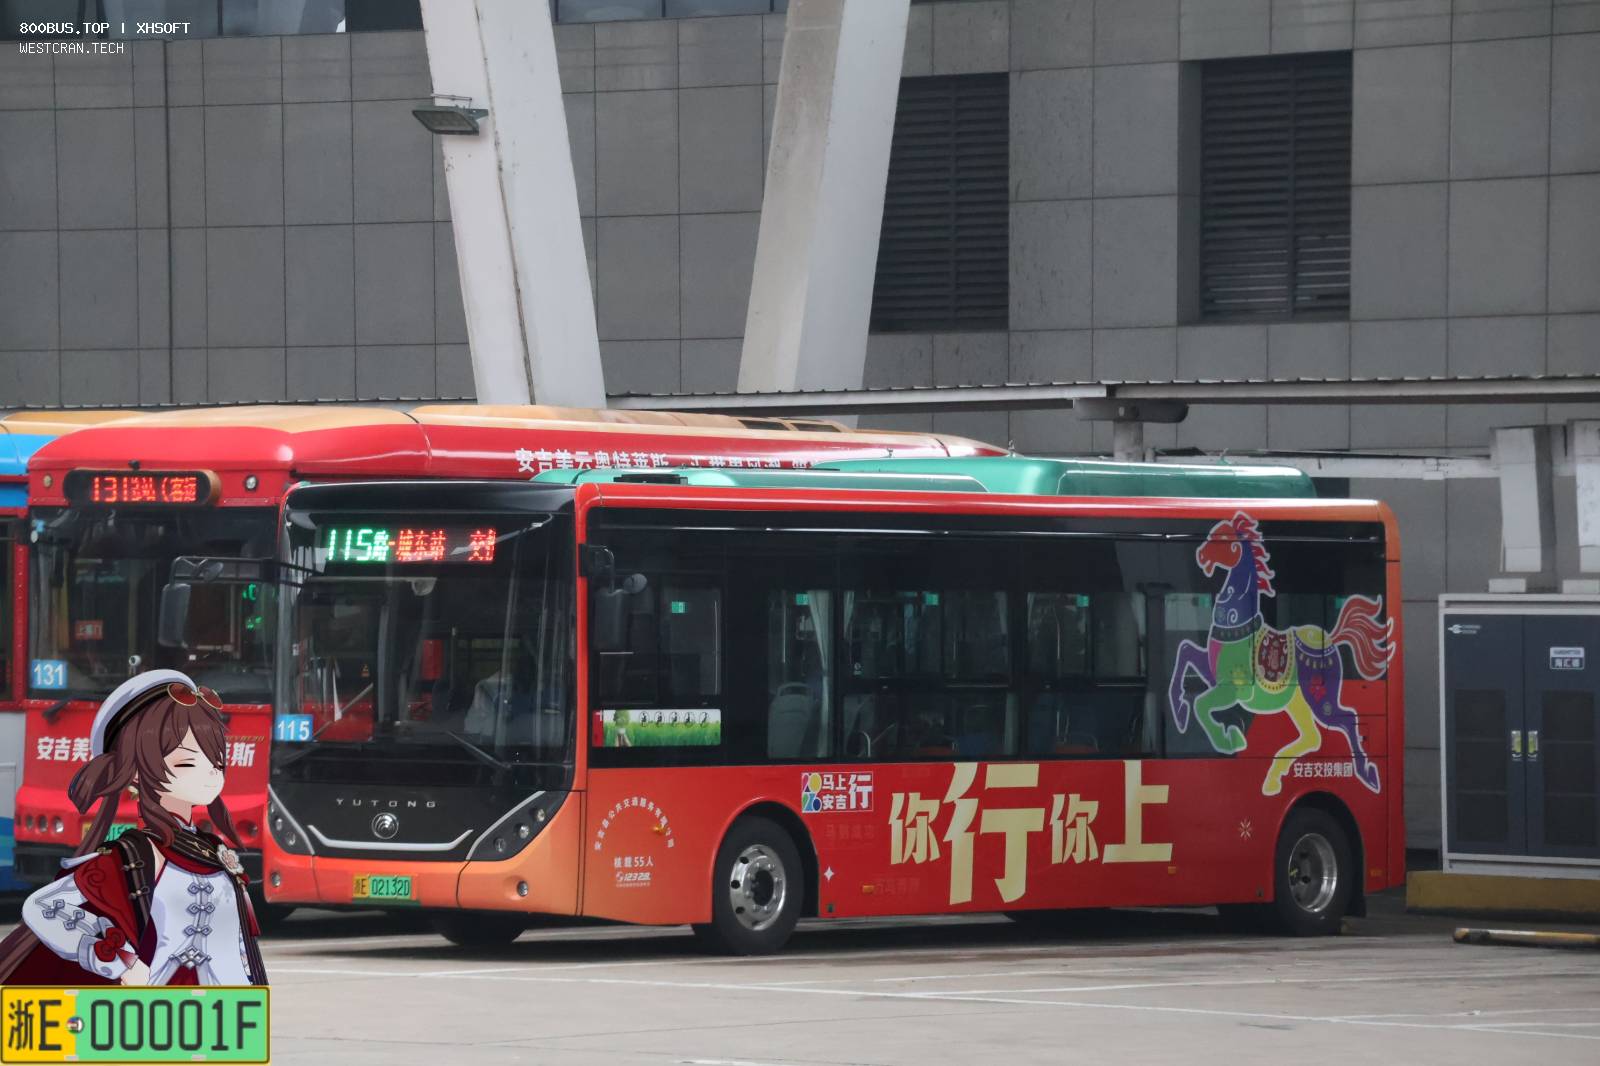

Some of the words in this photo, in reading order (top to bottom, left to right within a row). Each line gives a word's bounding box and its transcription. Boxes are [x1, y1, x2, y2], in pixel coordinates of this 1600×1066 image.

[33, 661, 65, 687] 131
[277, 719, 310, 741] 115
[1293, 762, 1354, 778] 安吉交投集团
[336, 798, 436, 808] YUTONG
[888, 759, 1173, 905] 你行你上
